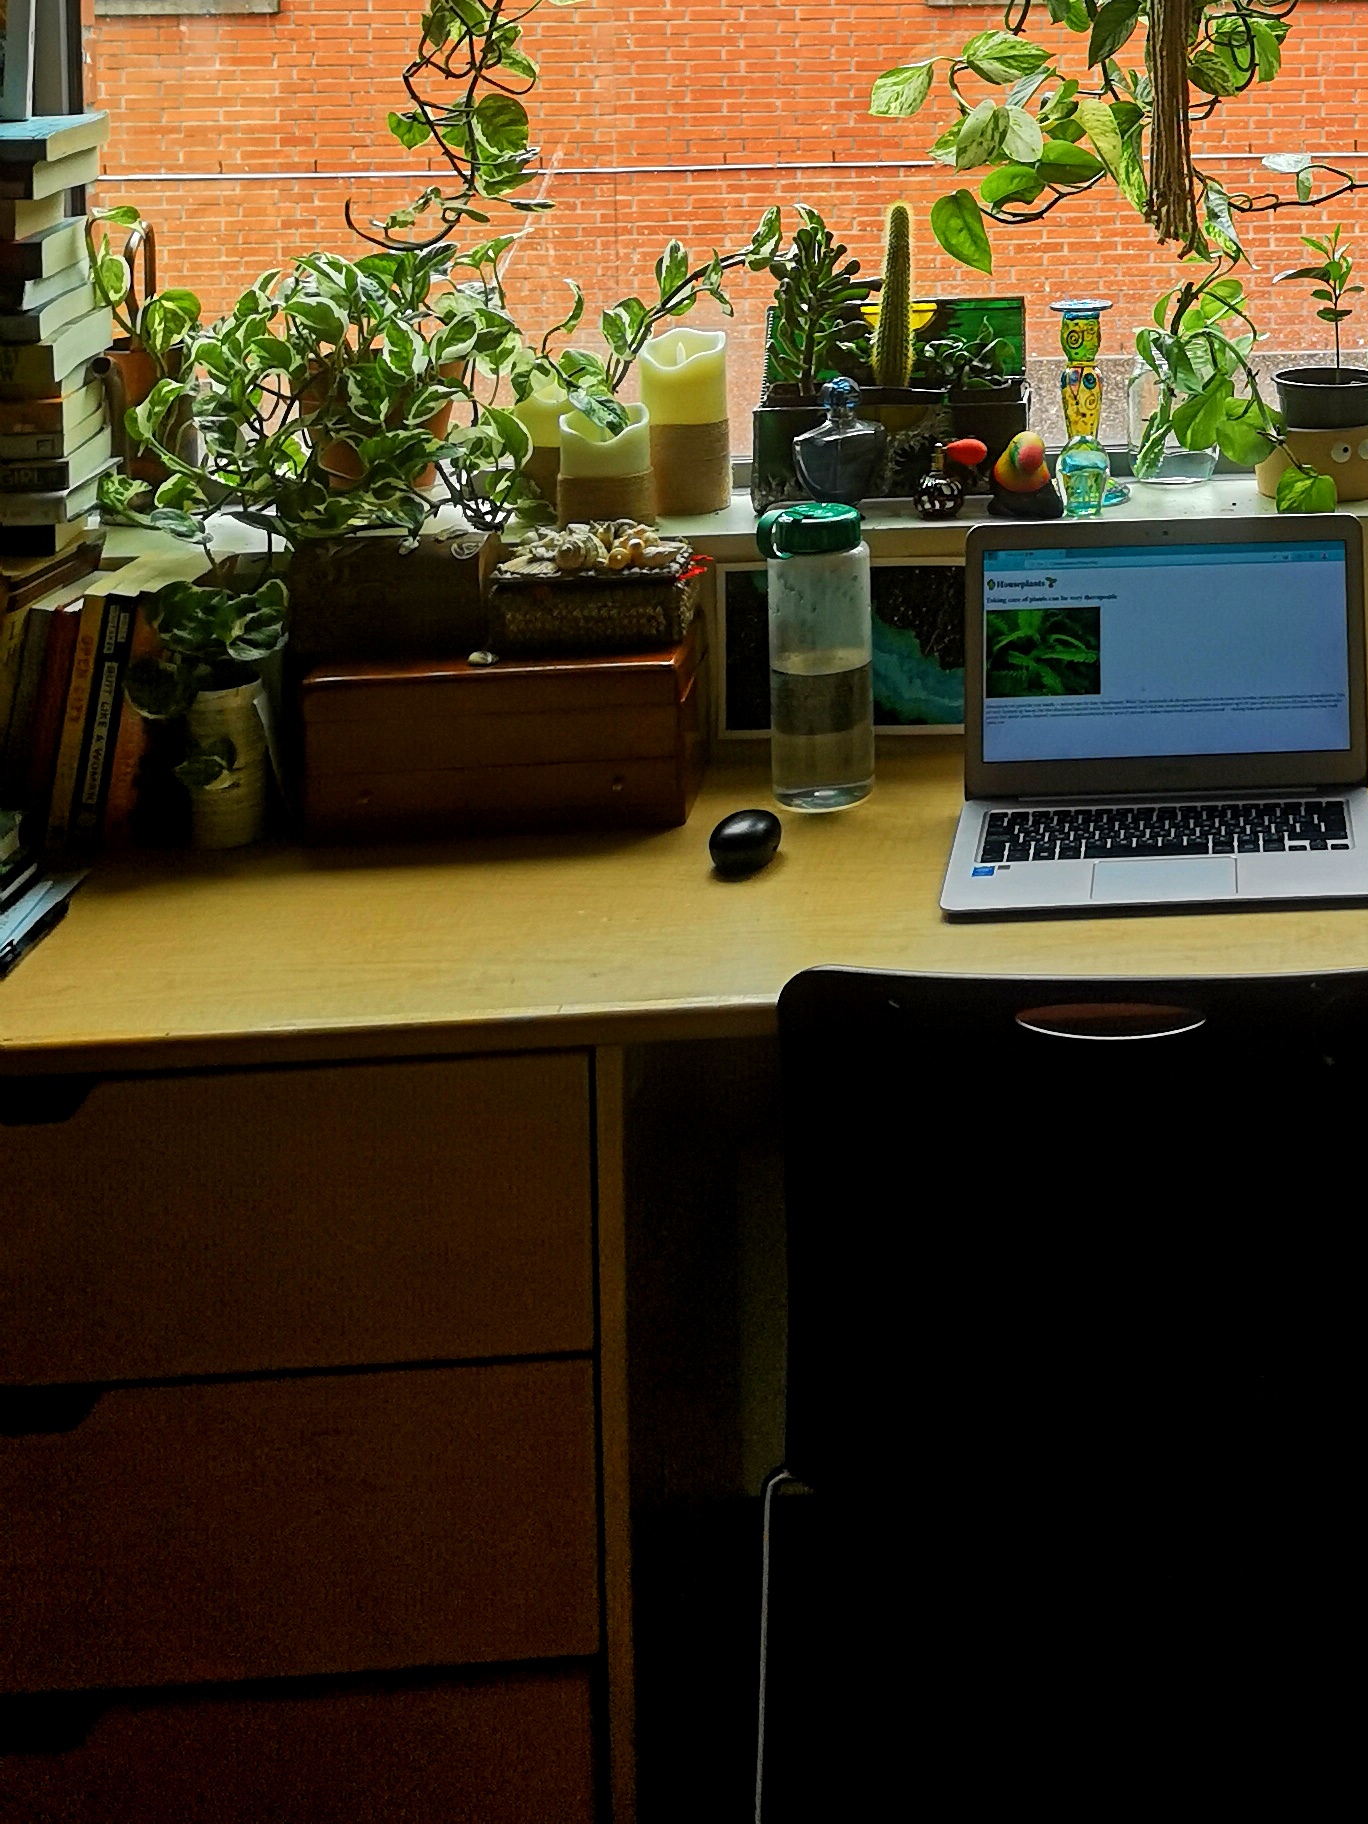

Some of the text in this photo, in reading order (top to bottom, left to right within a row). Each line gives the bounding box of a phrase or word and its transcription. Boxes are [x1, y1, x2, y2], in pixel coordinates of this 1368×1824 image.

[997, 579, 1046, 590] Houseplants
[97, 701, 109, 727] LIKE
[86, 748, 103, 802] WOMAN
